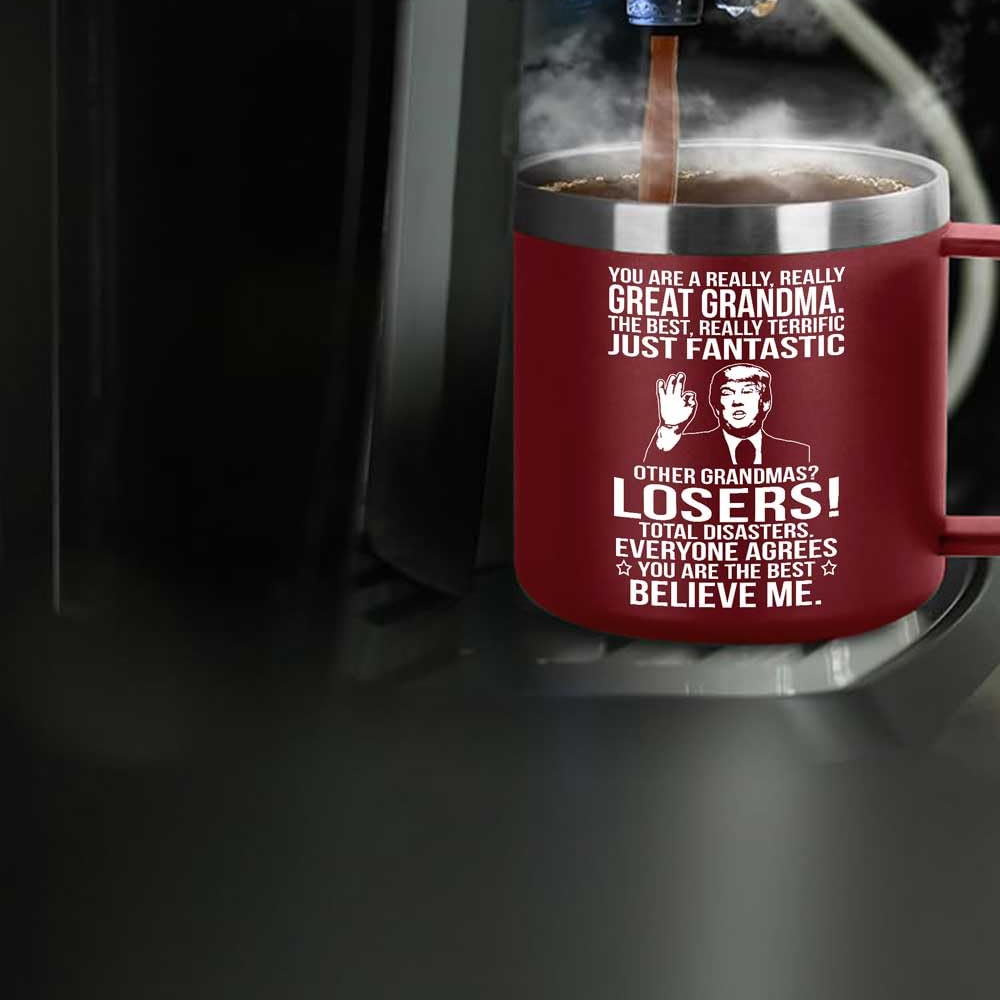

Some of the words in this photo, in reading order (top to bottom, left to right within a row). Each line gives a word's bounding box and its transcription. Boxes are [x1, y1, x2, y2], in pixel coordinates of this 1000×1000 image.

[608, 266, 643, 284] YOU
[649, 270, 684, 287] ARE
[688, 271, 701, 287] A
[706, 271, 774, 288] REALLY,
[780, 266, 846, 286] REALLY
[608, 284, 694, 317] GREAT
[701, 285, 845, 318] GRANDMA.
[608, 315, 642, 333] THE
[647, 317, 694, 337] BEST,
[700, 320, 763, 336] REALLY
[768, 315, 845, 335] TERRIFIC
[608, 334, 677, 359] JUST
[687, 334, 845, 360] FANTASTIC
[633, 465, 696, 484] OTHER
[700, 465, 819, 485] GRANDMAS?
[613, 476, 840, 523] LOSERS!
[639, 522, 698, 540] TOTAL
[703, 522, 814, 540] DISASTERS.
[615, 537, 738, 561] EVERYONE
[745, 537, 838, 561] AGREES
[638, 562, 675, 578] YOU
[681, 563, 719, 579] ARE
[724, 564, 761, 579] THE
[767, 561, 816, 579] BEST
[629, 579, 756, 609] BELIEVE
[766, 580, 822, 608] ME.
